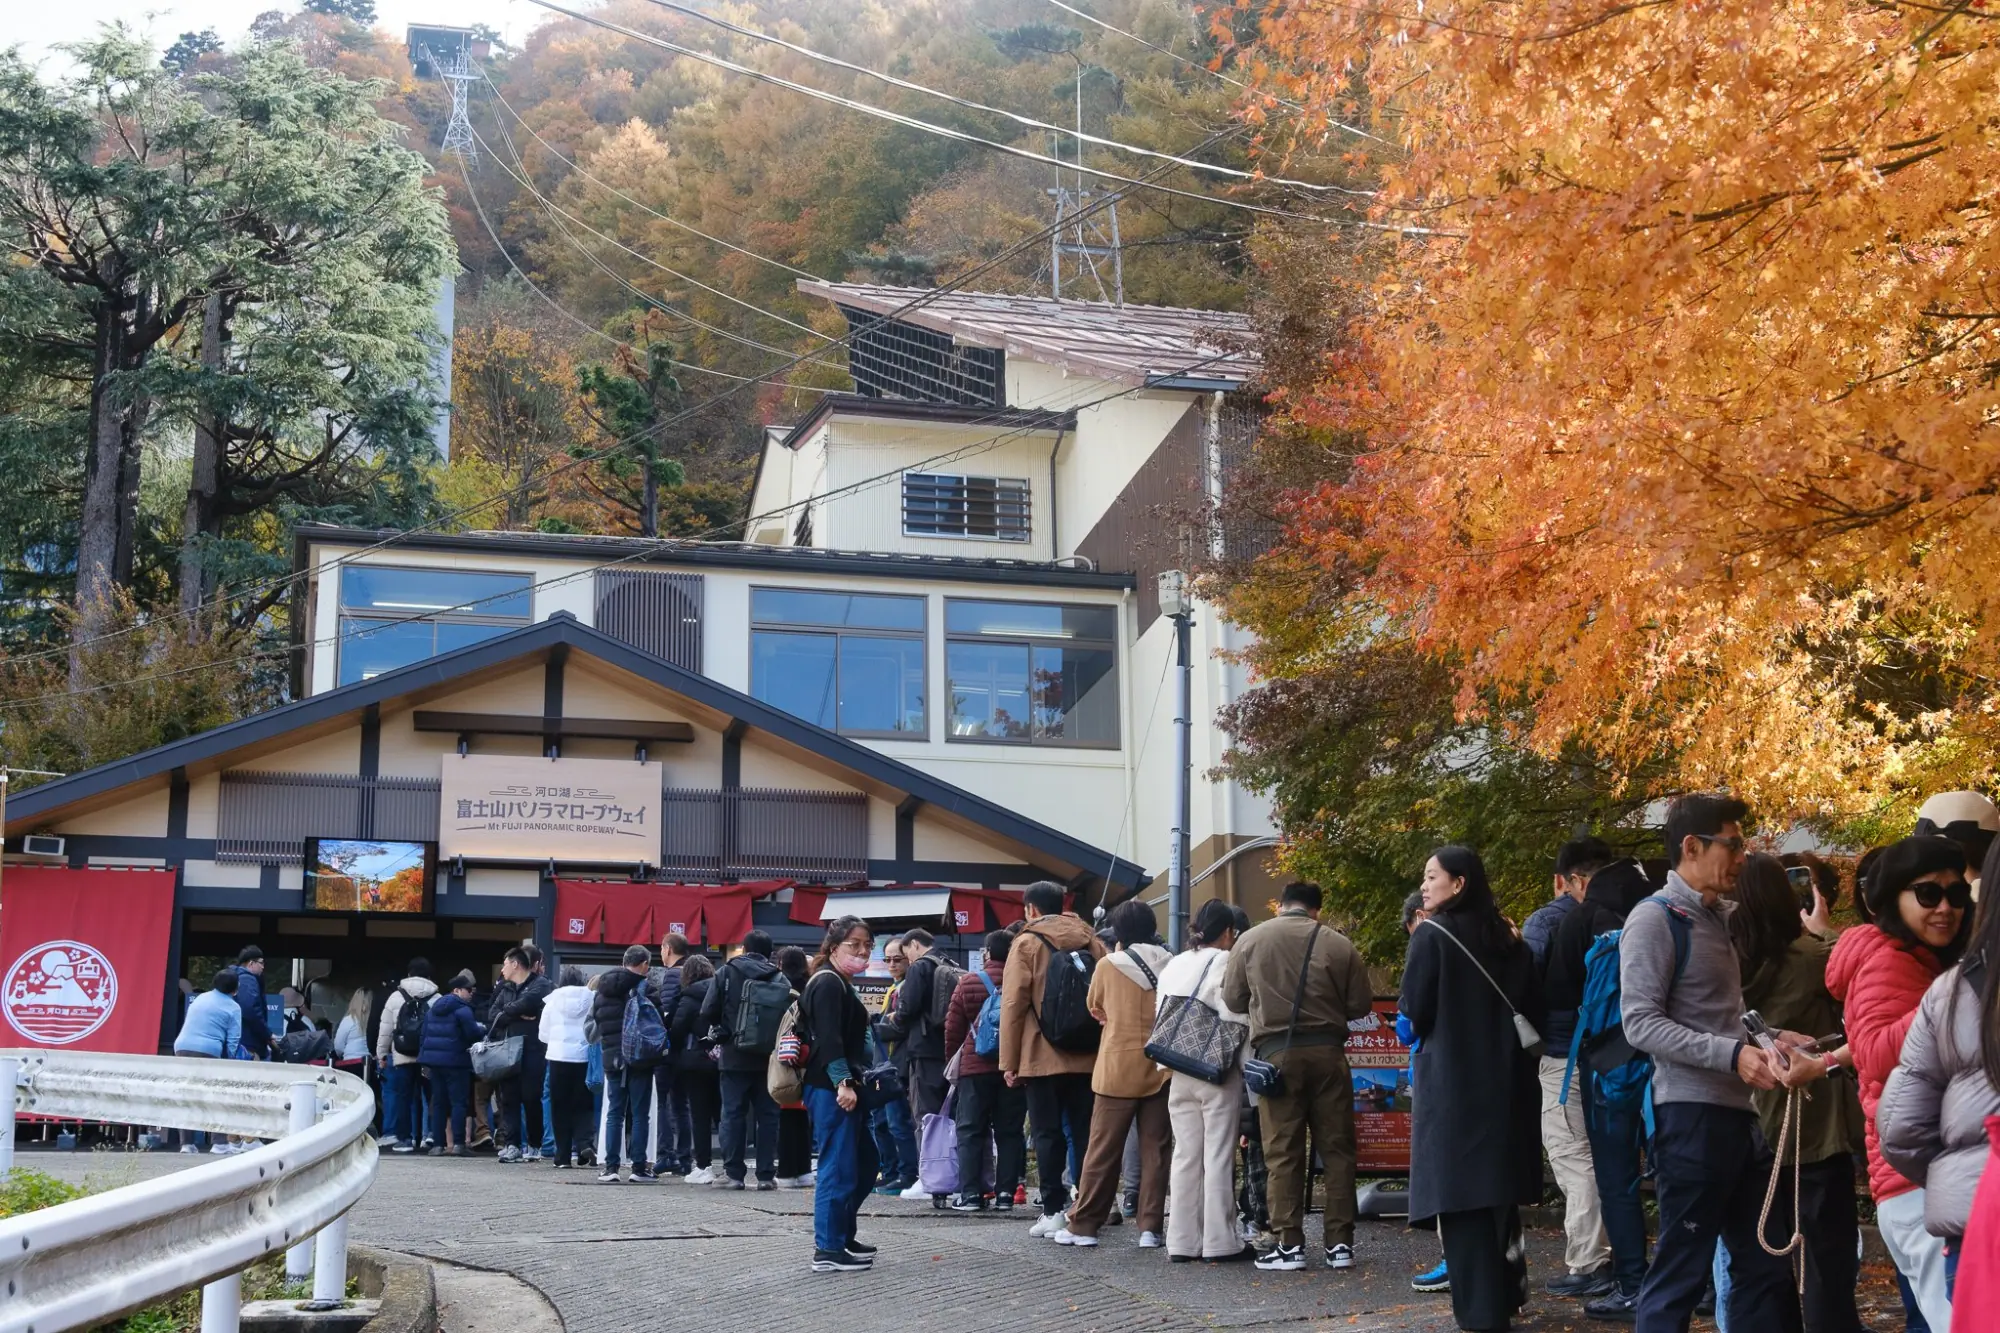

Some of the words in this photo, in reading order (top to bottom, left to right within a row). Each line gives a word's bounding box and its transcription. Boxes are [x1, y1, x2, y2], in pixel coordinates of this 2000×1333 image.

[535, 786, 571, 798] 河口湖
[456, 799, 646, 825] 富士山パノラマロープウェイ
[487, 822, 500, 831] Mt
[501, 822, 523, 831] FUJI
[524, 823, 575, 832] PANORAMIC
[576, 824, 616, 835] ROPEWAY
[46, 1007, 70, 1016] 河口湖
[1344, 1035, 1412, 1048] お得なセット
